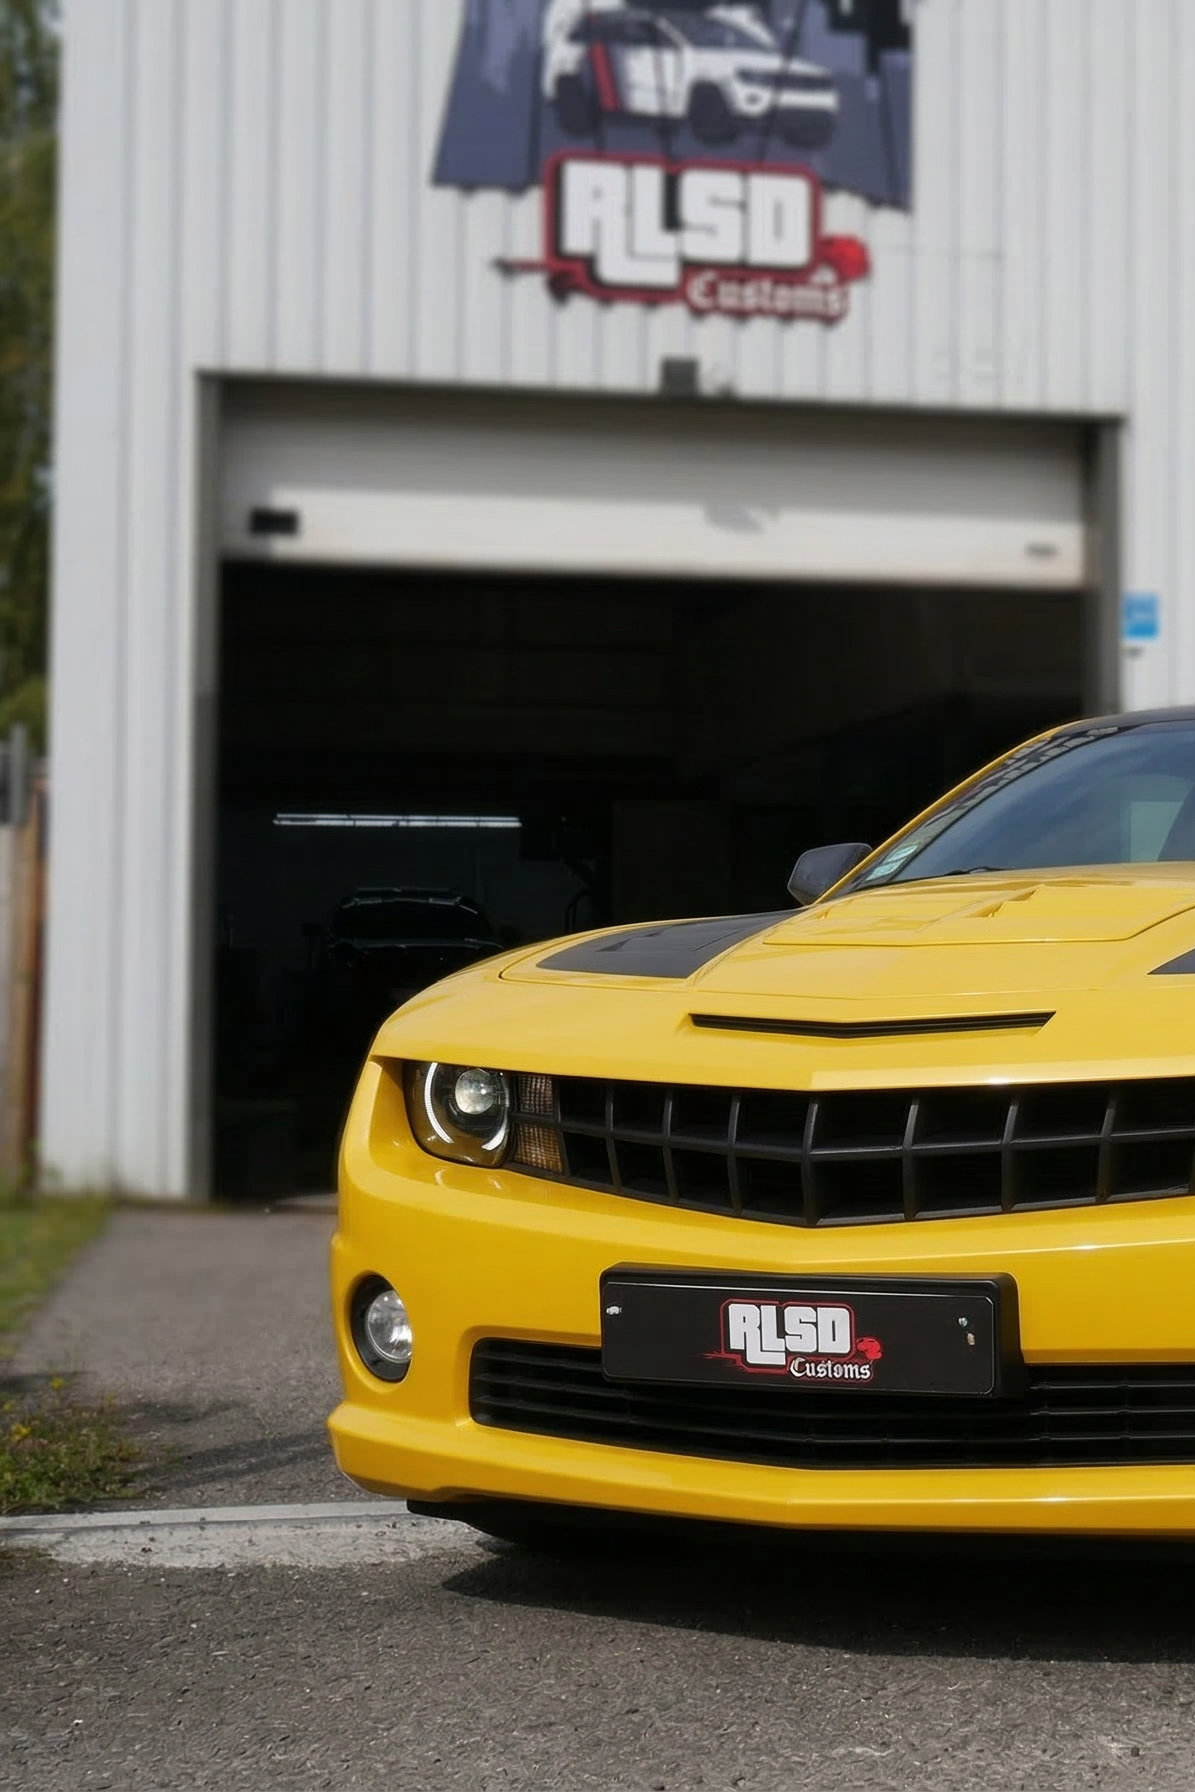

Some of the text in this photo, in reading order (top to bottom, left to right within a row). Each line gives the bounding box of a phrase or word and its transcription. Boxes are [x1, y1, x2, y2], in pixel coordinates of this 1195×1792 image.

[562, 159, 812, 287] RLSD
[728, 1303, 851, 1365] RLSD
[790, 1357, 871, 1379] Customs
